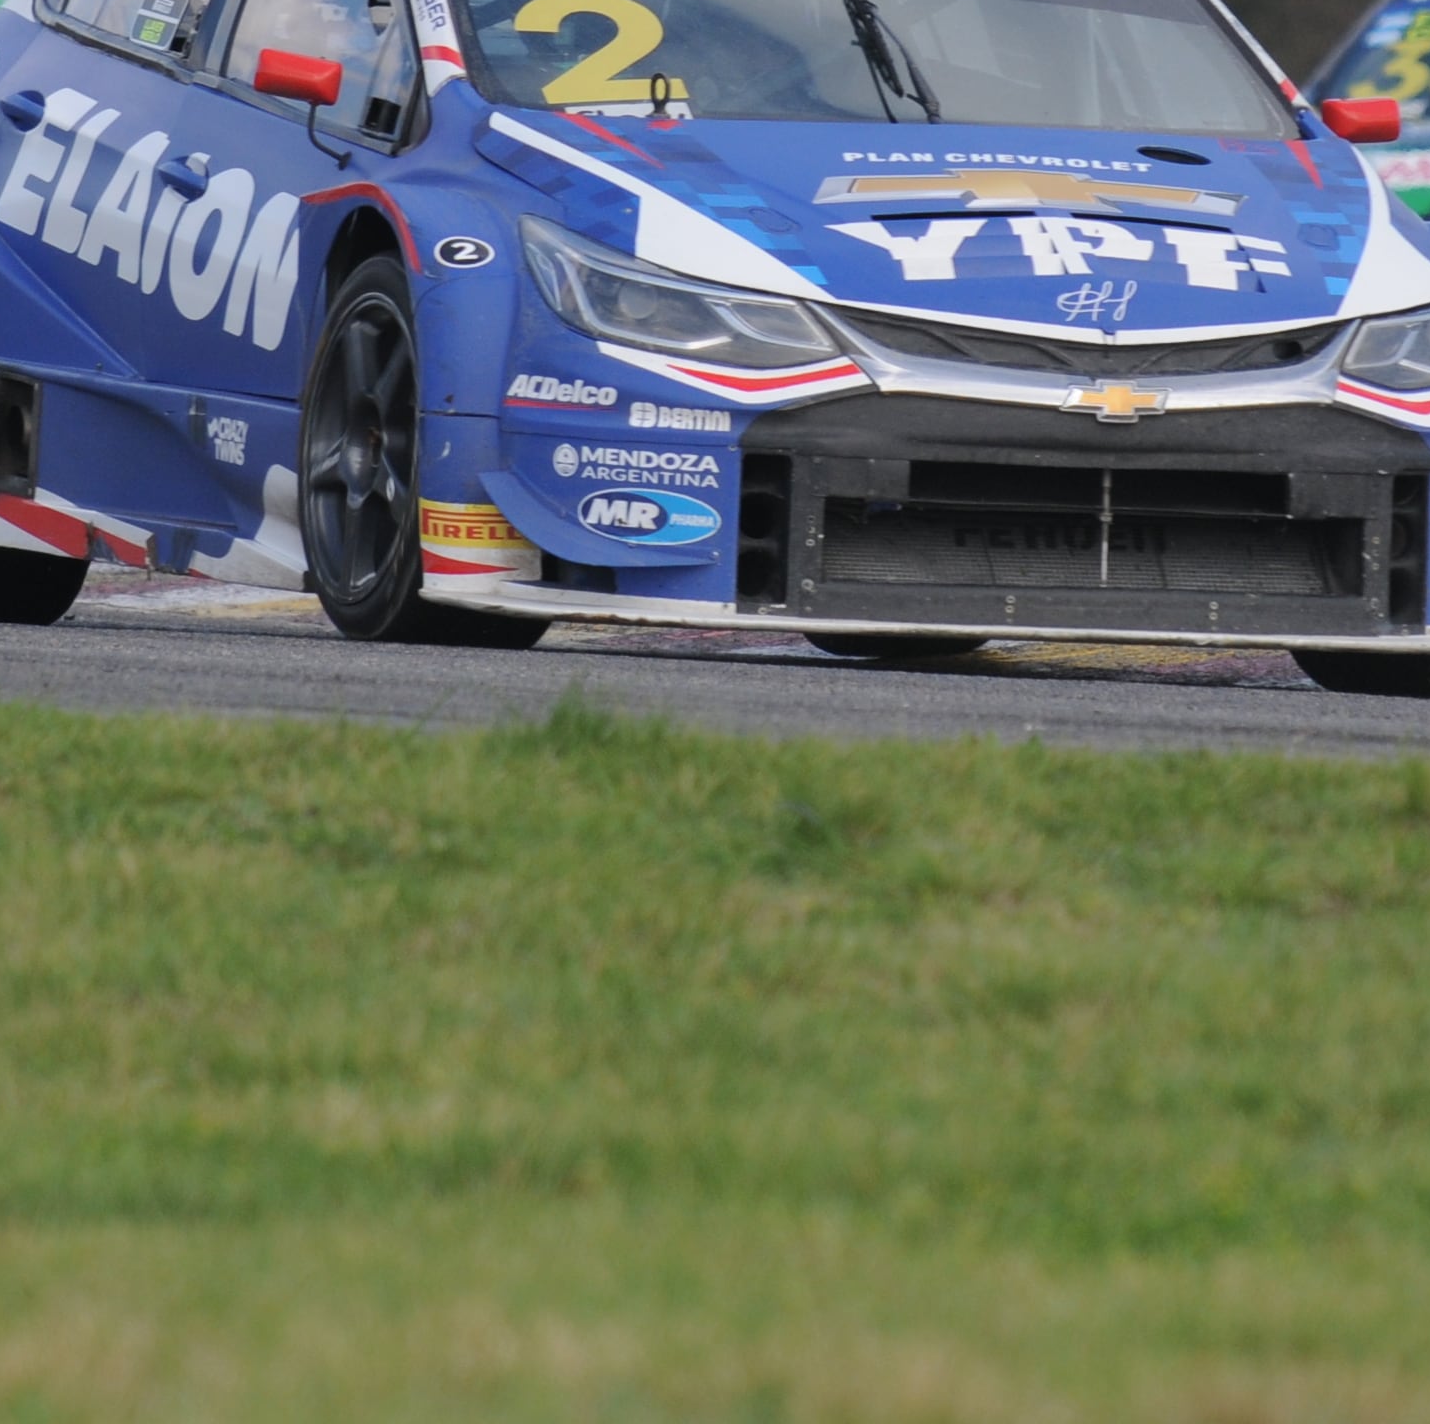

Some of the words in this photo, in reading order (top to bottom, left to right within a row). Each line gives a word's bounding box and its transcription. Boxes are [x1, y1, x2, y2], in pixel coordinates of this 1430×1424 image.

[842, 151, 938, 166] PLAN
[944, 152, 1152, 174] CHEVROLET
[450, 241, 480, 261] 2
[825, 217, 1292, 293] YPF
[507, 373, 618, 407] ACDelco
[657, 406, 732, 433] BERTINI
[581, 444, 720, 474] MENDOZA
[580, 464, 719, 489] ARGENTINA
[585, 497, 660, 530] MR
